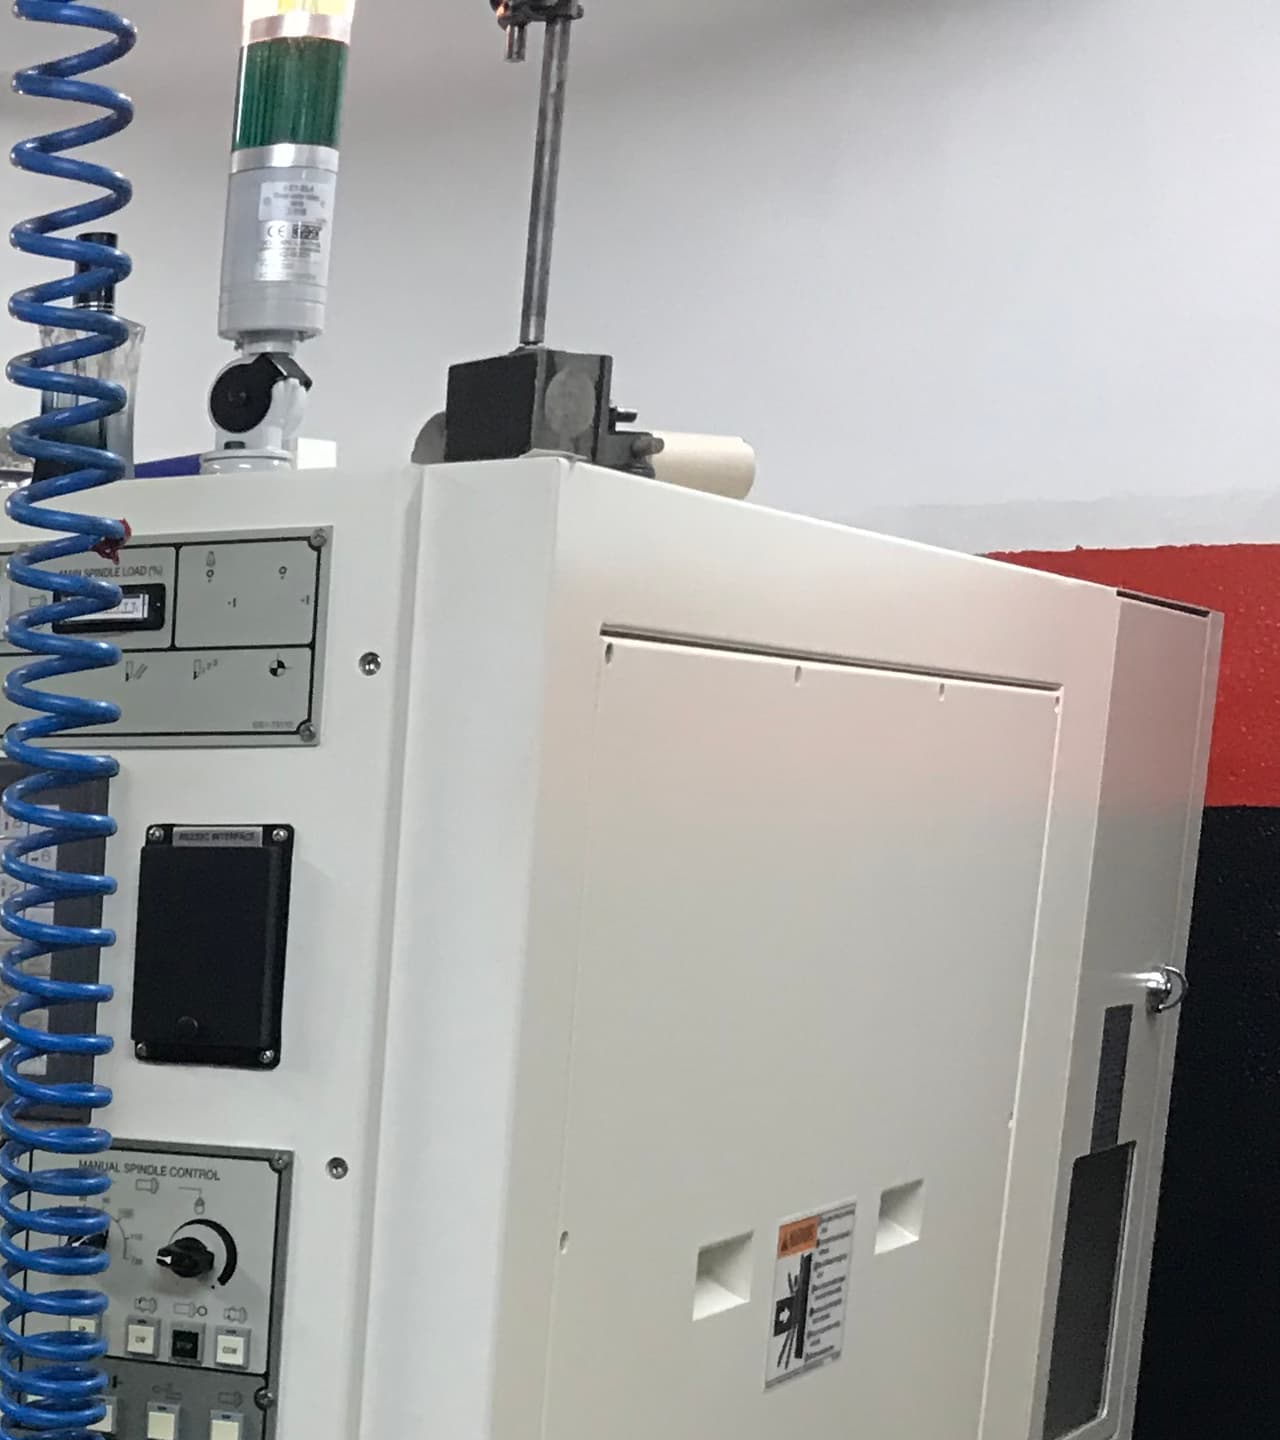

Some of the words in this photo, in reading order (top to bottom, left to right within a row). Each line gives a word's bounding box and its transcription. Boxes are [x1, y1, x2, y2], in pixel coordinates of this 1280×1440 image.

[122, 566, 146, 577] LOAD
[78, 1159, 120, 1173] MANUAL
[124, 1163, 167, 1177] SPINDLE
[169, 1166, 221, 1181] CONTROL
